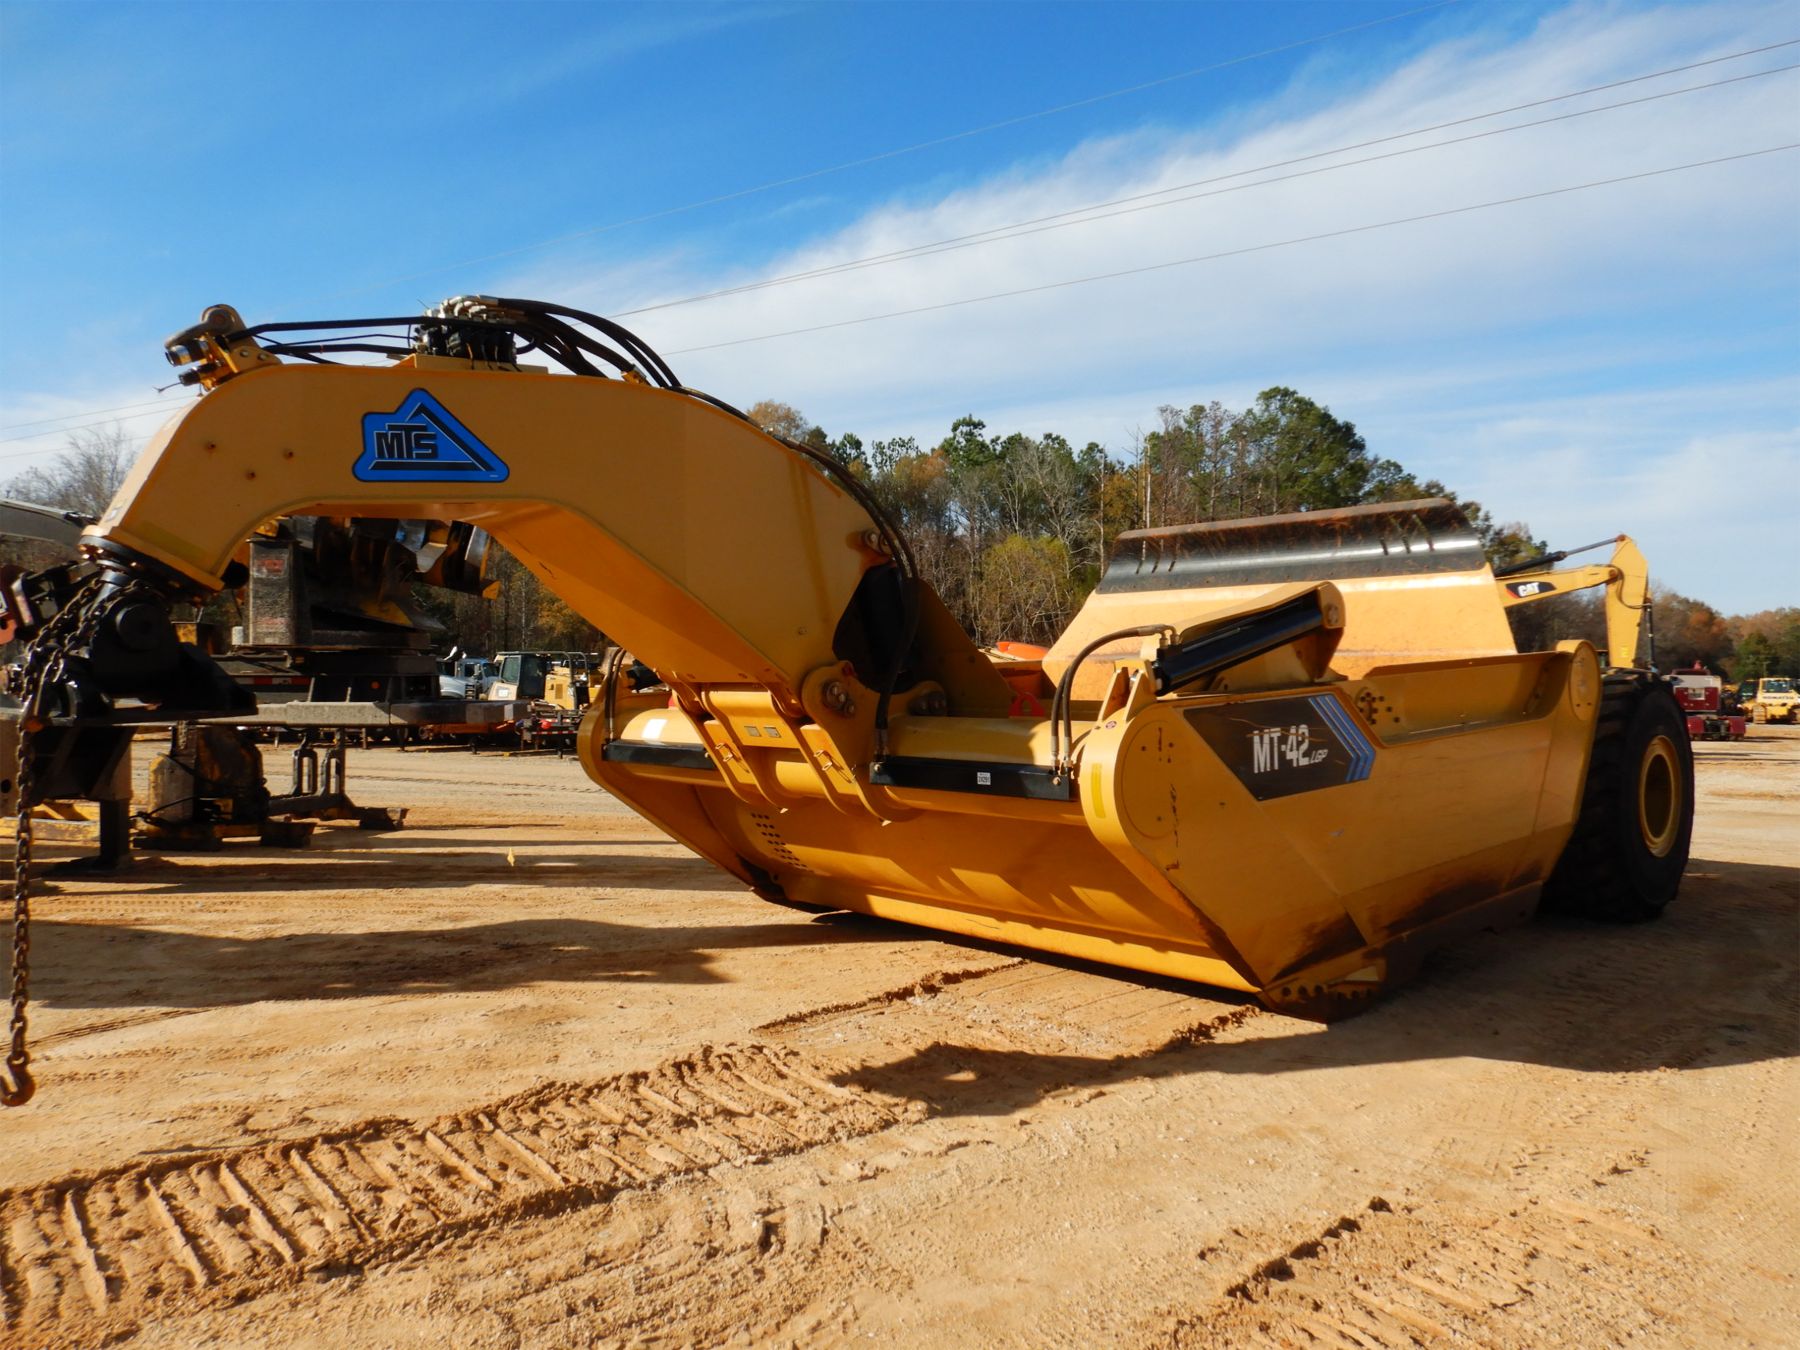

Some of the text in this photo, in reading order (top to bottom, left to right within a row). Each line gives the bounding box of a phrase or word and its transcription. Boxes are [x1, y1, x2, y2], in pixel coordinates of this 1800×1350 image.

[374, 423, 439, 459] MTS
[1517, 582, 1539, 598] CAT
[1253, 724, 1328, 774] MT-42 LGP
